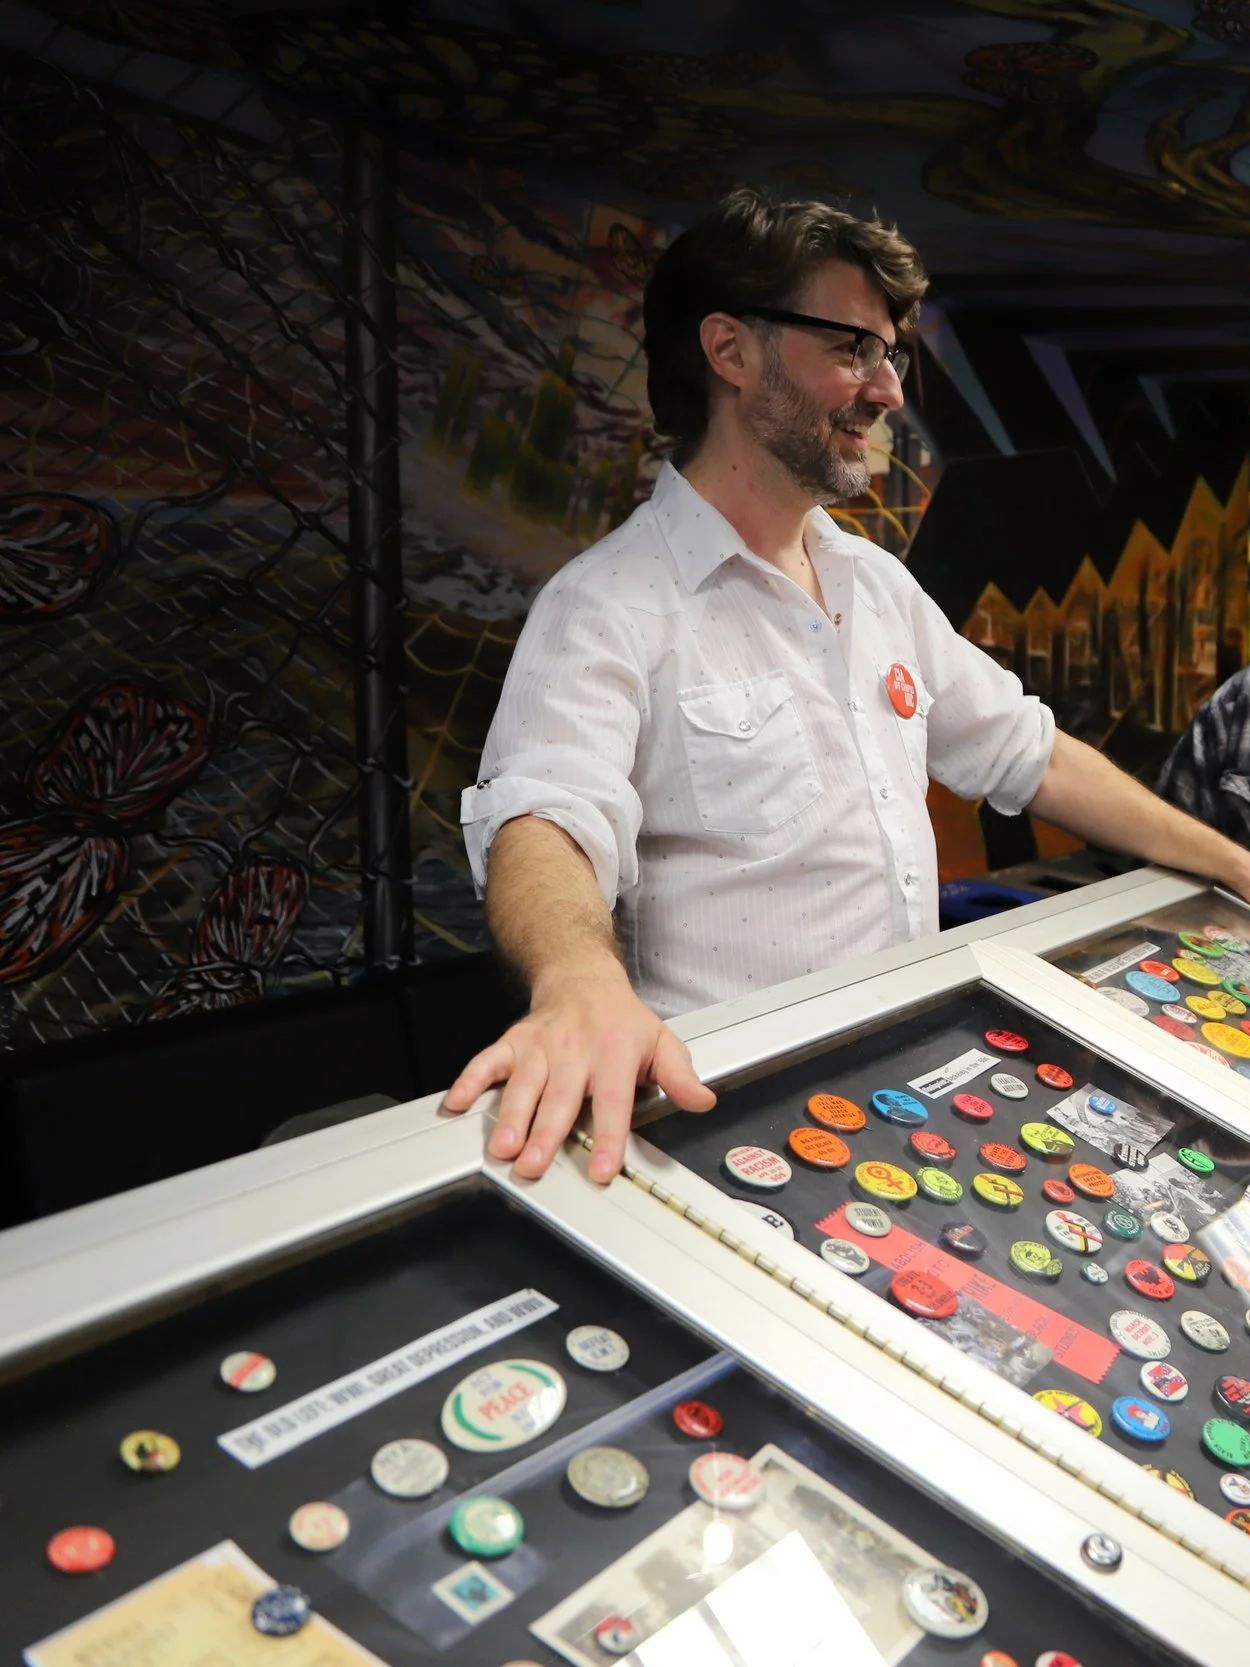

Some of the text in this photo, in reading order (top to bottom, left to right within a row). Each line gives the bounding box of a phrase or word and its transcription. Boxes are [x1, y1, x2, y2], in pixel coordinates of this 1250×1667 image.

[732, 1149, 766, 1167] AGAINST
[740, 1156, 779, 1176] RACISM
[854, 1207, 881, 1218] STUDENT
[861, 1217, 884, 1228] POWER
[890, 1241, 926, 1272] ABOLISH
[1054, 1327, 1081, 1358] STUDIES
[477, 1382, 536, 1422] PEACE
